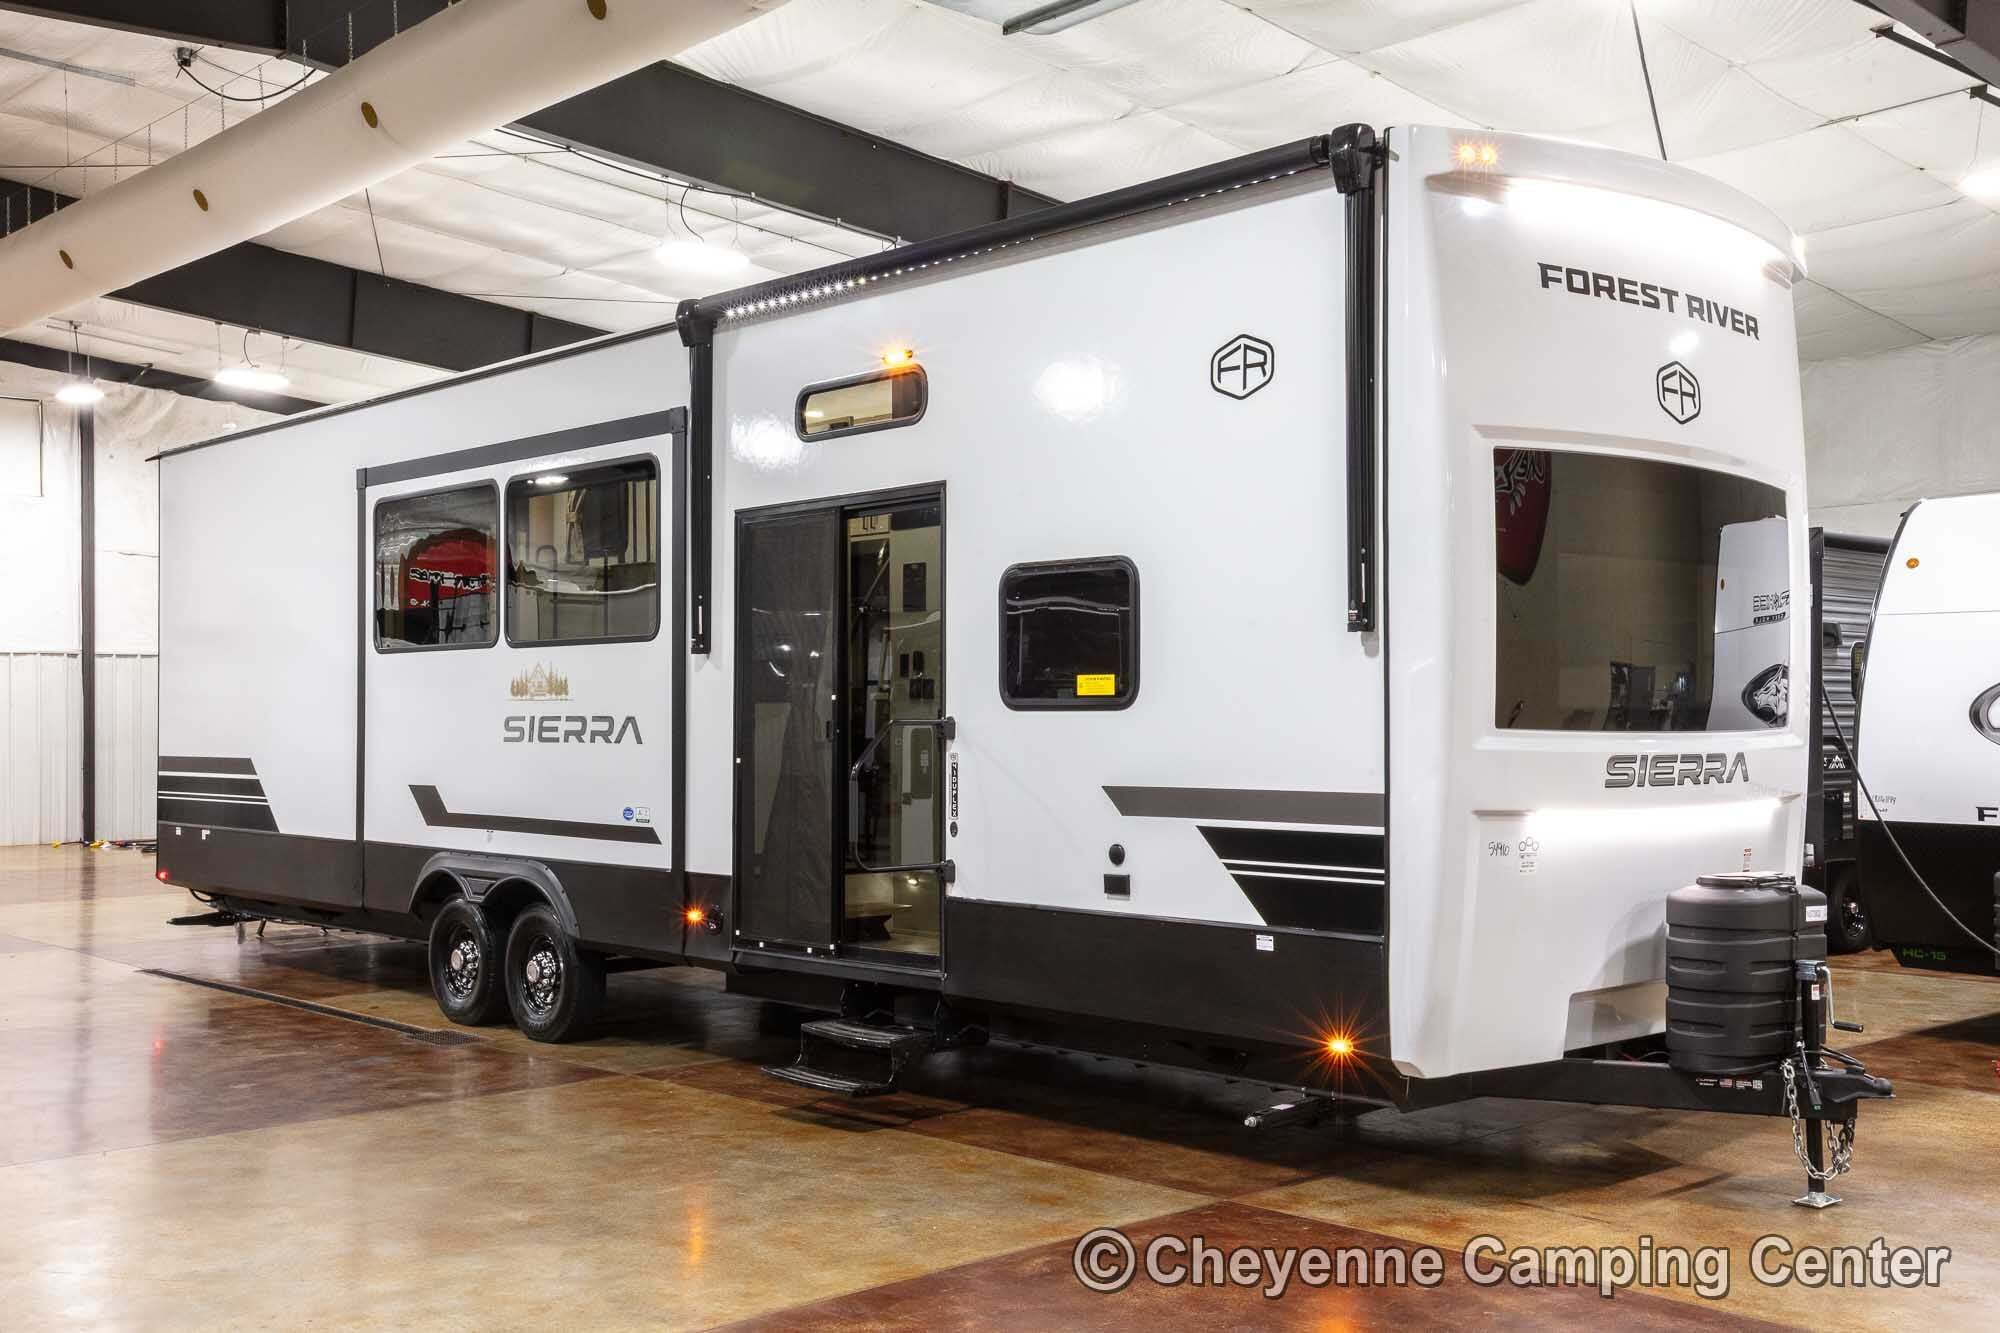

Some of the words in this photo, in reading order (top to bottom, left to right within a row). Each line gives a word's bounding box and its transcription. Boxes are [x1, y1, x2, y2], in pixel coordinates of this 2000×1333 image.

[1538, 262, 1679, 313] FOREST
[1685, 292, 1760, 341] RIVER
[503, 715, 643, 745] SIERRA
[1604, 752, 1749, 789] SIERRA
